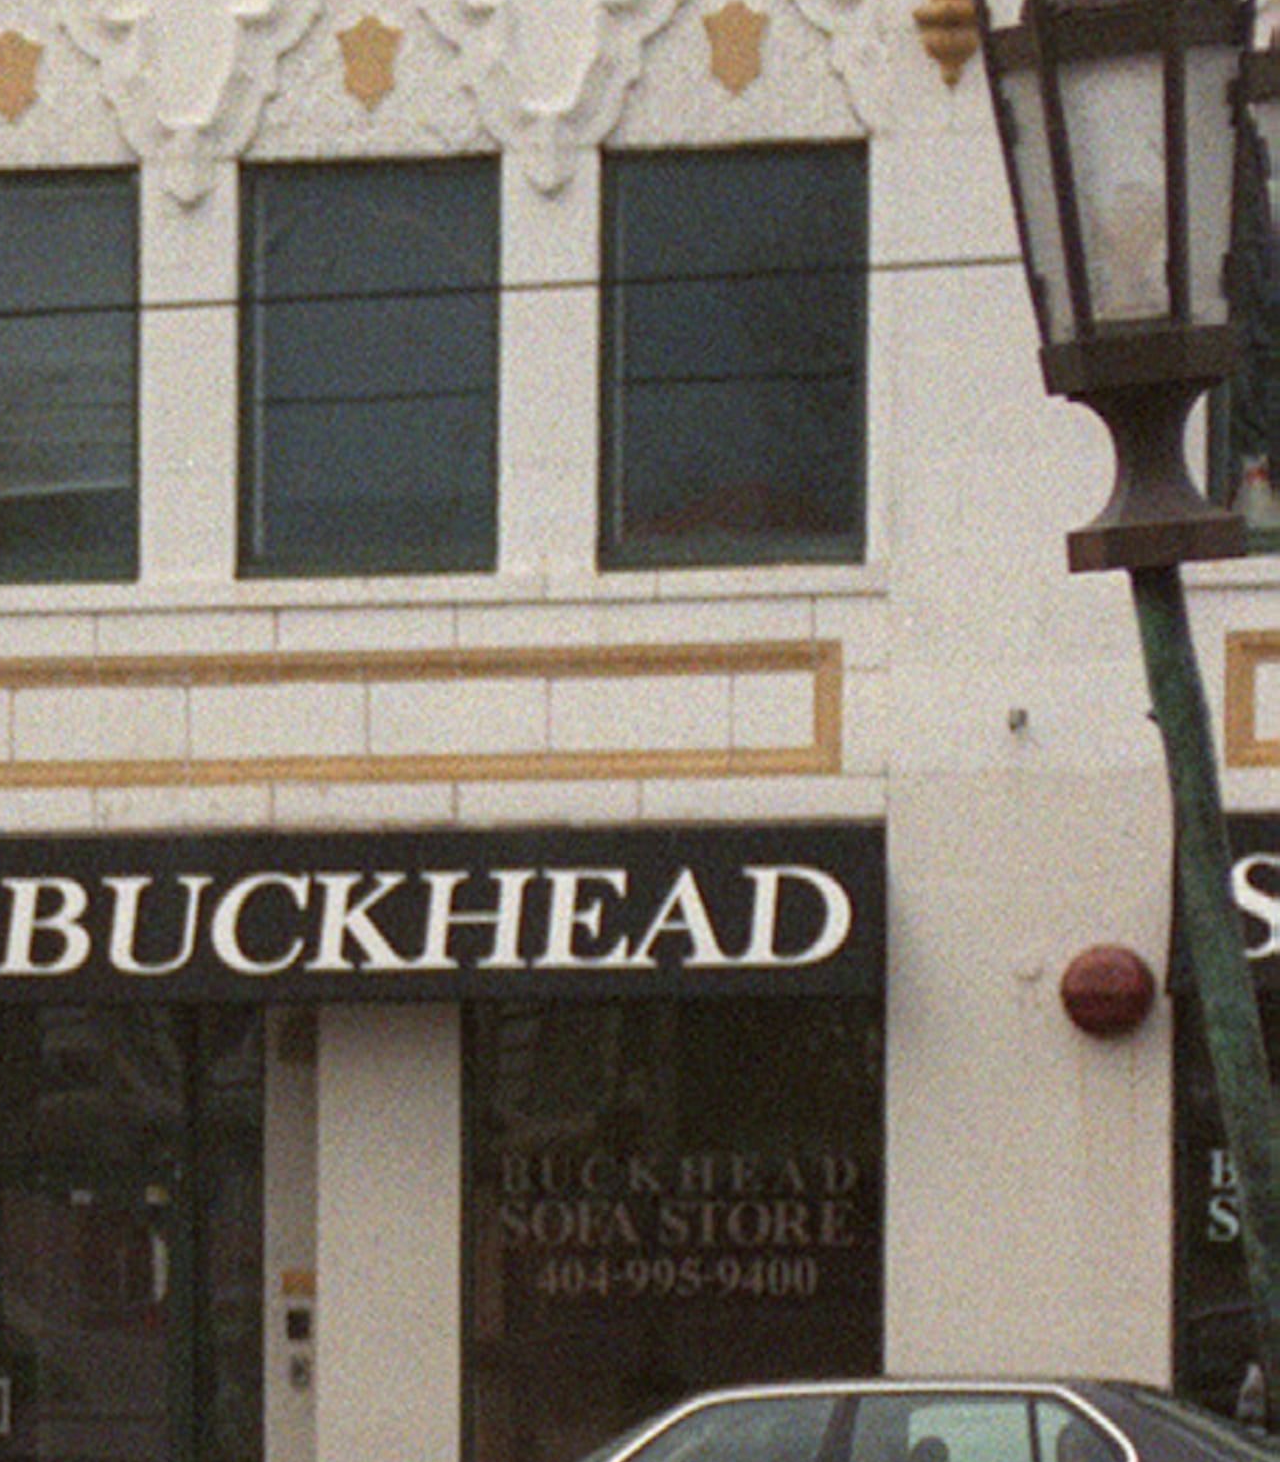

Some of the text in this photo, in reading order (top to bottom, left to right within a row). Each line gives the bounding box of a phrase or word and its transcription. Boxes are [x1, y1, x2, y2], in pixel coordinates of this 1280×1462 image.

[500, 1152, 860, 1194] BUCKHEAD
[499, 1198, 857, 1247] SOFA STORE
